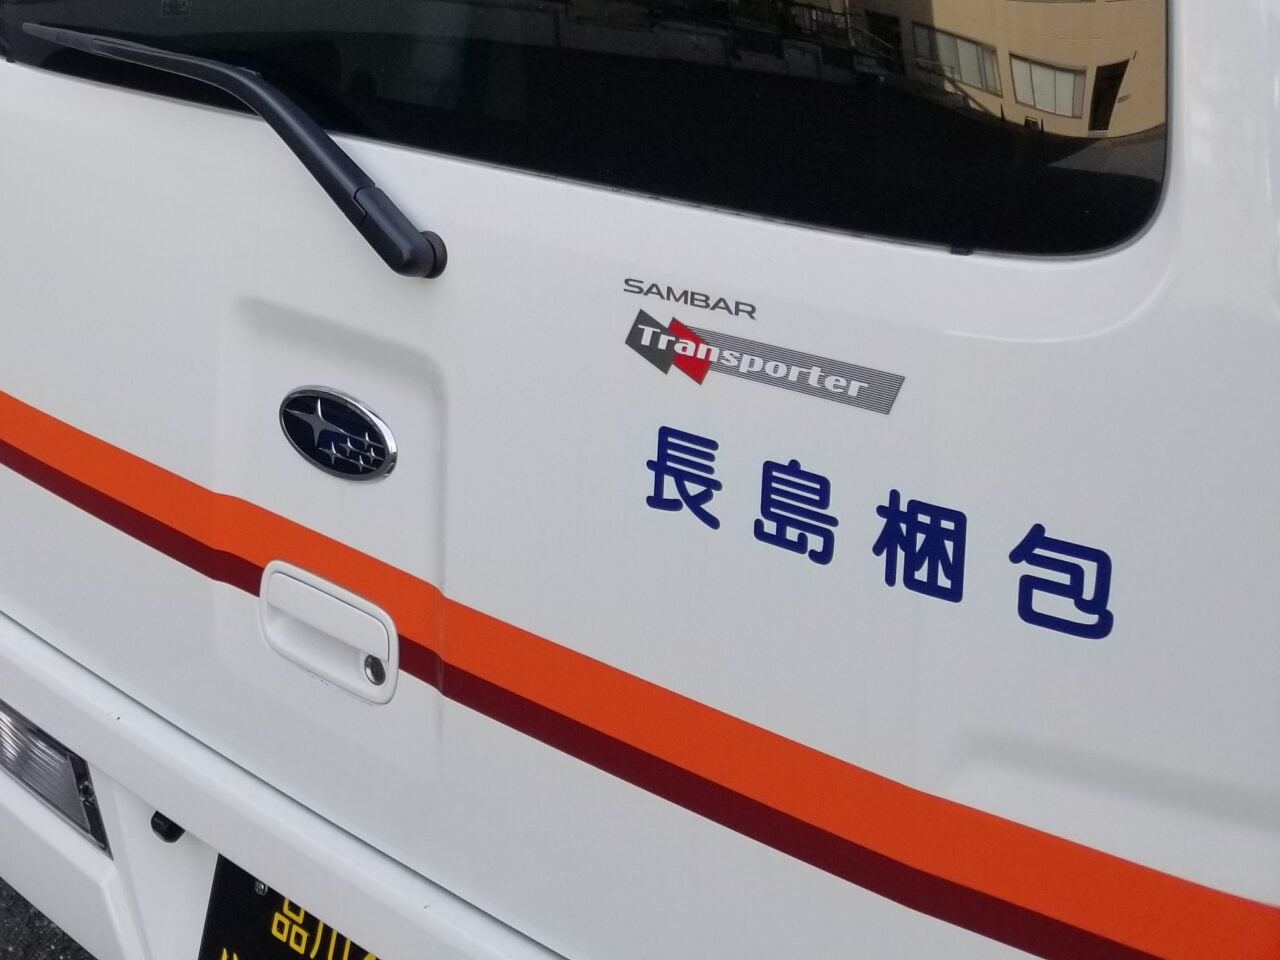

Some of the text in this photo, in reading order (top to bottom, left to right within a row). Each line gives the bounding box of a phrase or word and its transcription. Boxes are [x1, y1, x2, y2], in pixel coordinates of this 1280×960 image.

[623, 277, 758, 321] SAMBAR
[637, 323, 869, 398] Transporter
[645, 425, 1114, 640] 長島梱包
